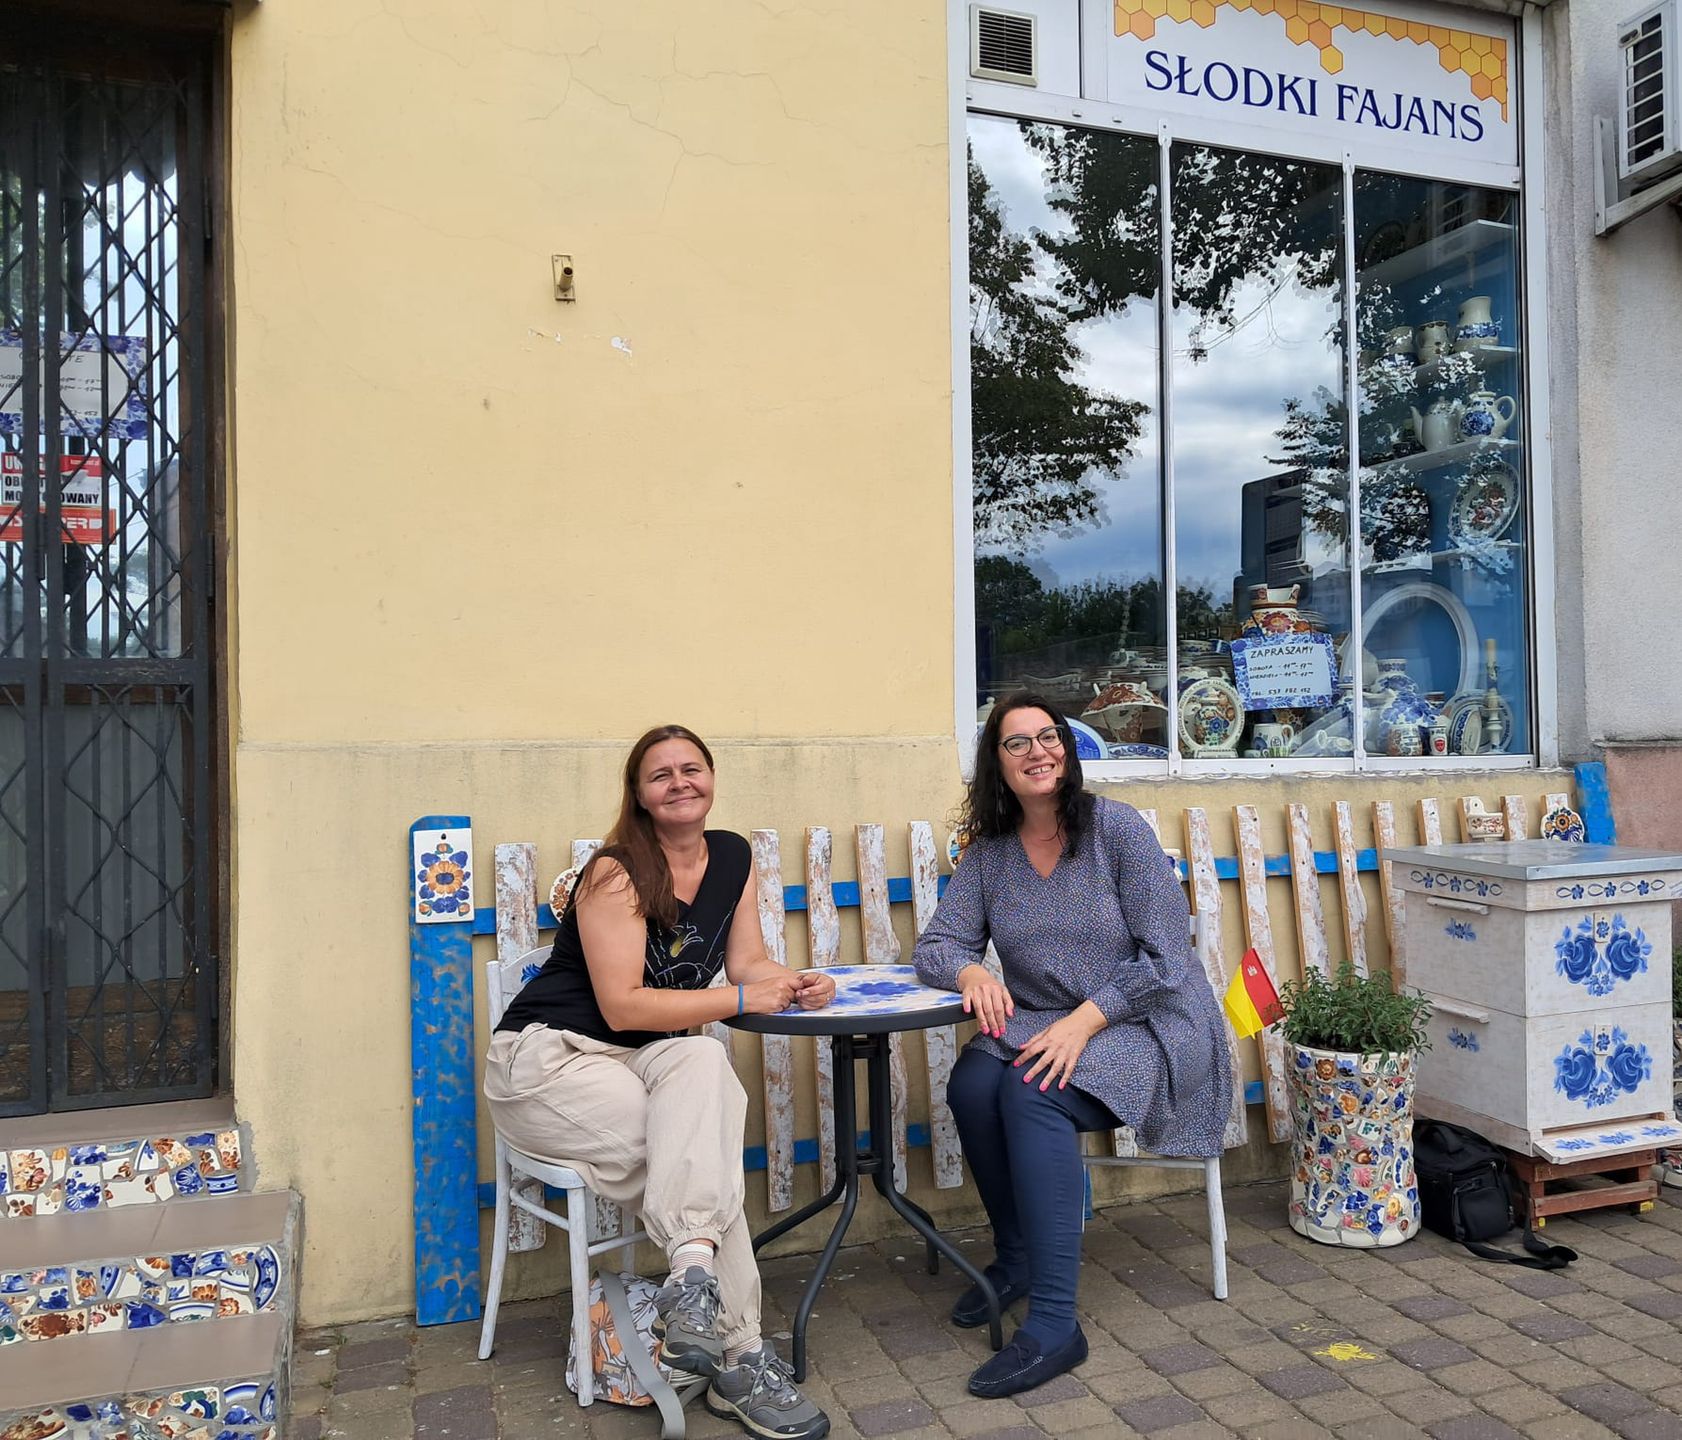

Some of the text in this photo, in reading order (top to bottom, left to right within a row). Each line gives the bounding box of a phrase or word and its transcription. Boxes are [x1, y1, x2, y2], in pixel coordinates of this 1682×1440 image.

[1144, 49, 1485, 142] SŁODKI FAJANS
[1250, 646, 1314, 659] ZAPRASZAMY
